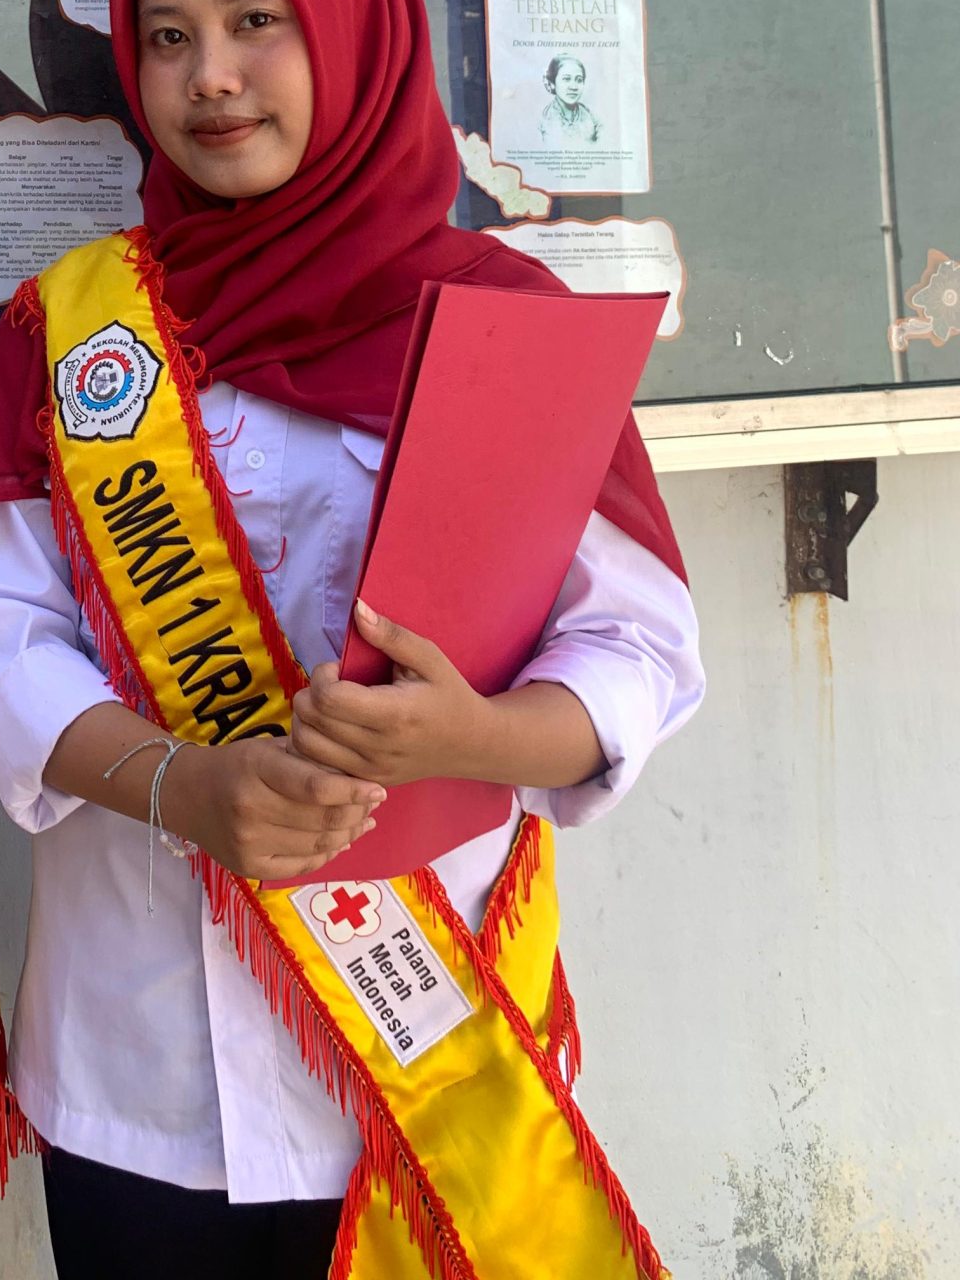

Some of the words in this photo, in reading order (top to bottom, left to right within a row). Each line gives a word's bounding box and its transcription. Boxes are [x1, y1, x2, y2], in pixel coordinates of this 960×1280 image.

[527, 17, 605, 34] TERANG
[91, 338, 130, 350] SEKOLAH
[129, 344, 147, 391] MENENGAH
[100, 393, 142, 426] KEJURUAN
[93, 460, 205, 606] SMKN
[157, 597, 222, 636] 1
[368, 942, 412, 1001] Merah
[391, 927, 438, 992] Palang
[346, 956, 414, 1051] Indonesia
